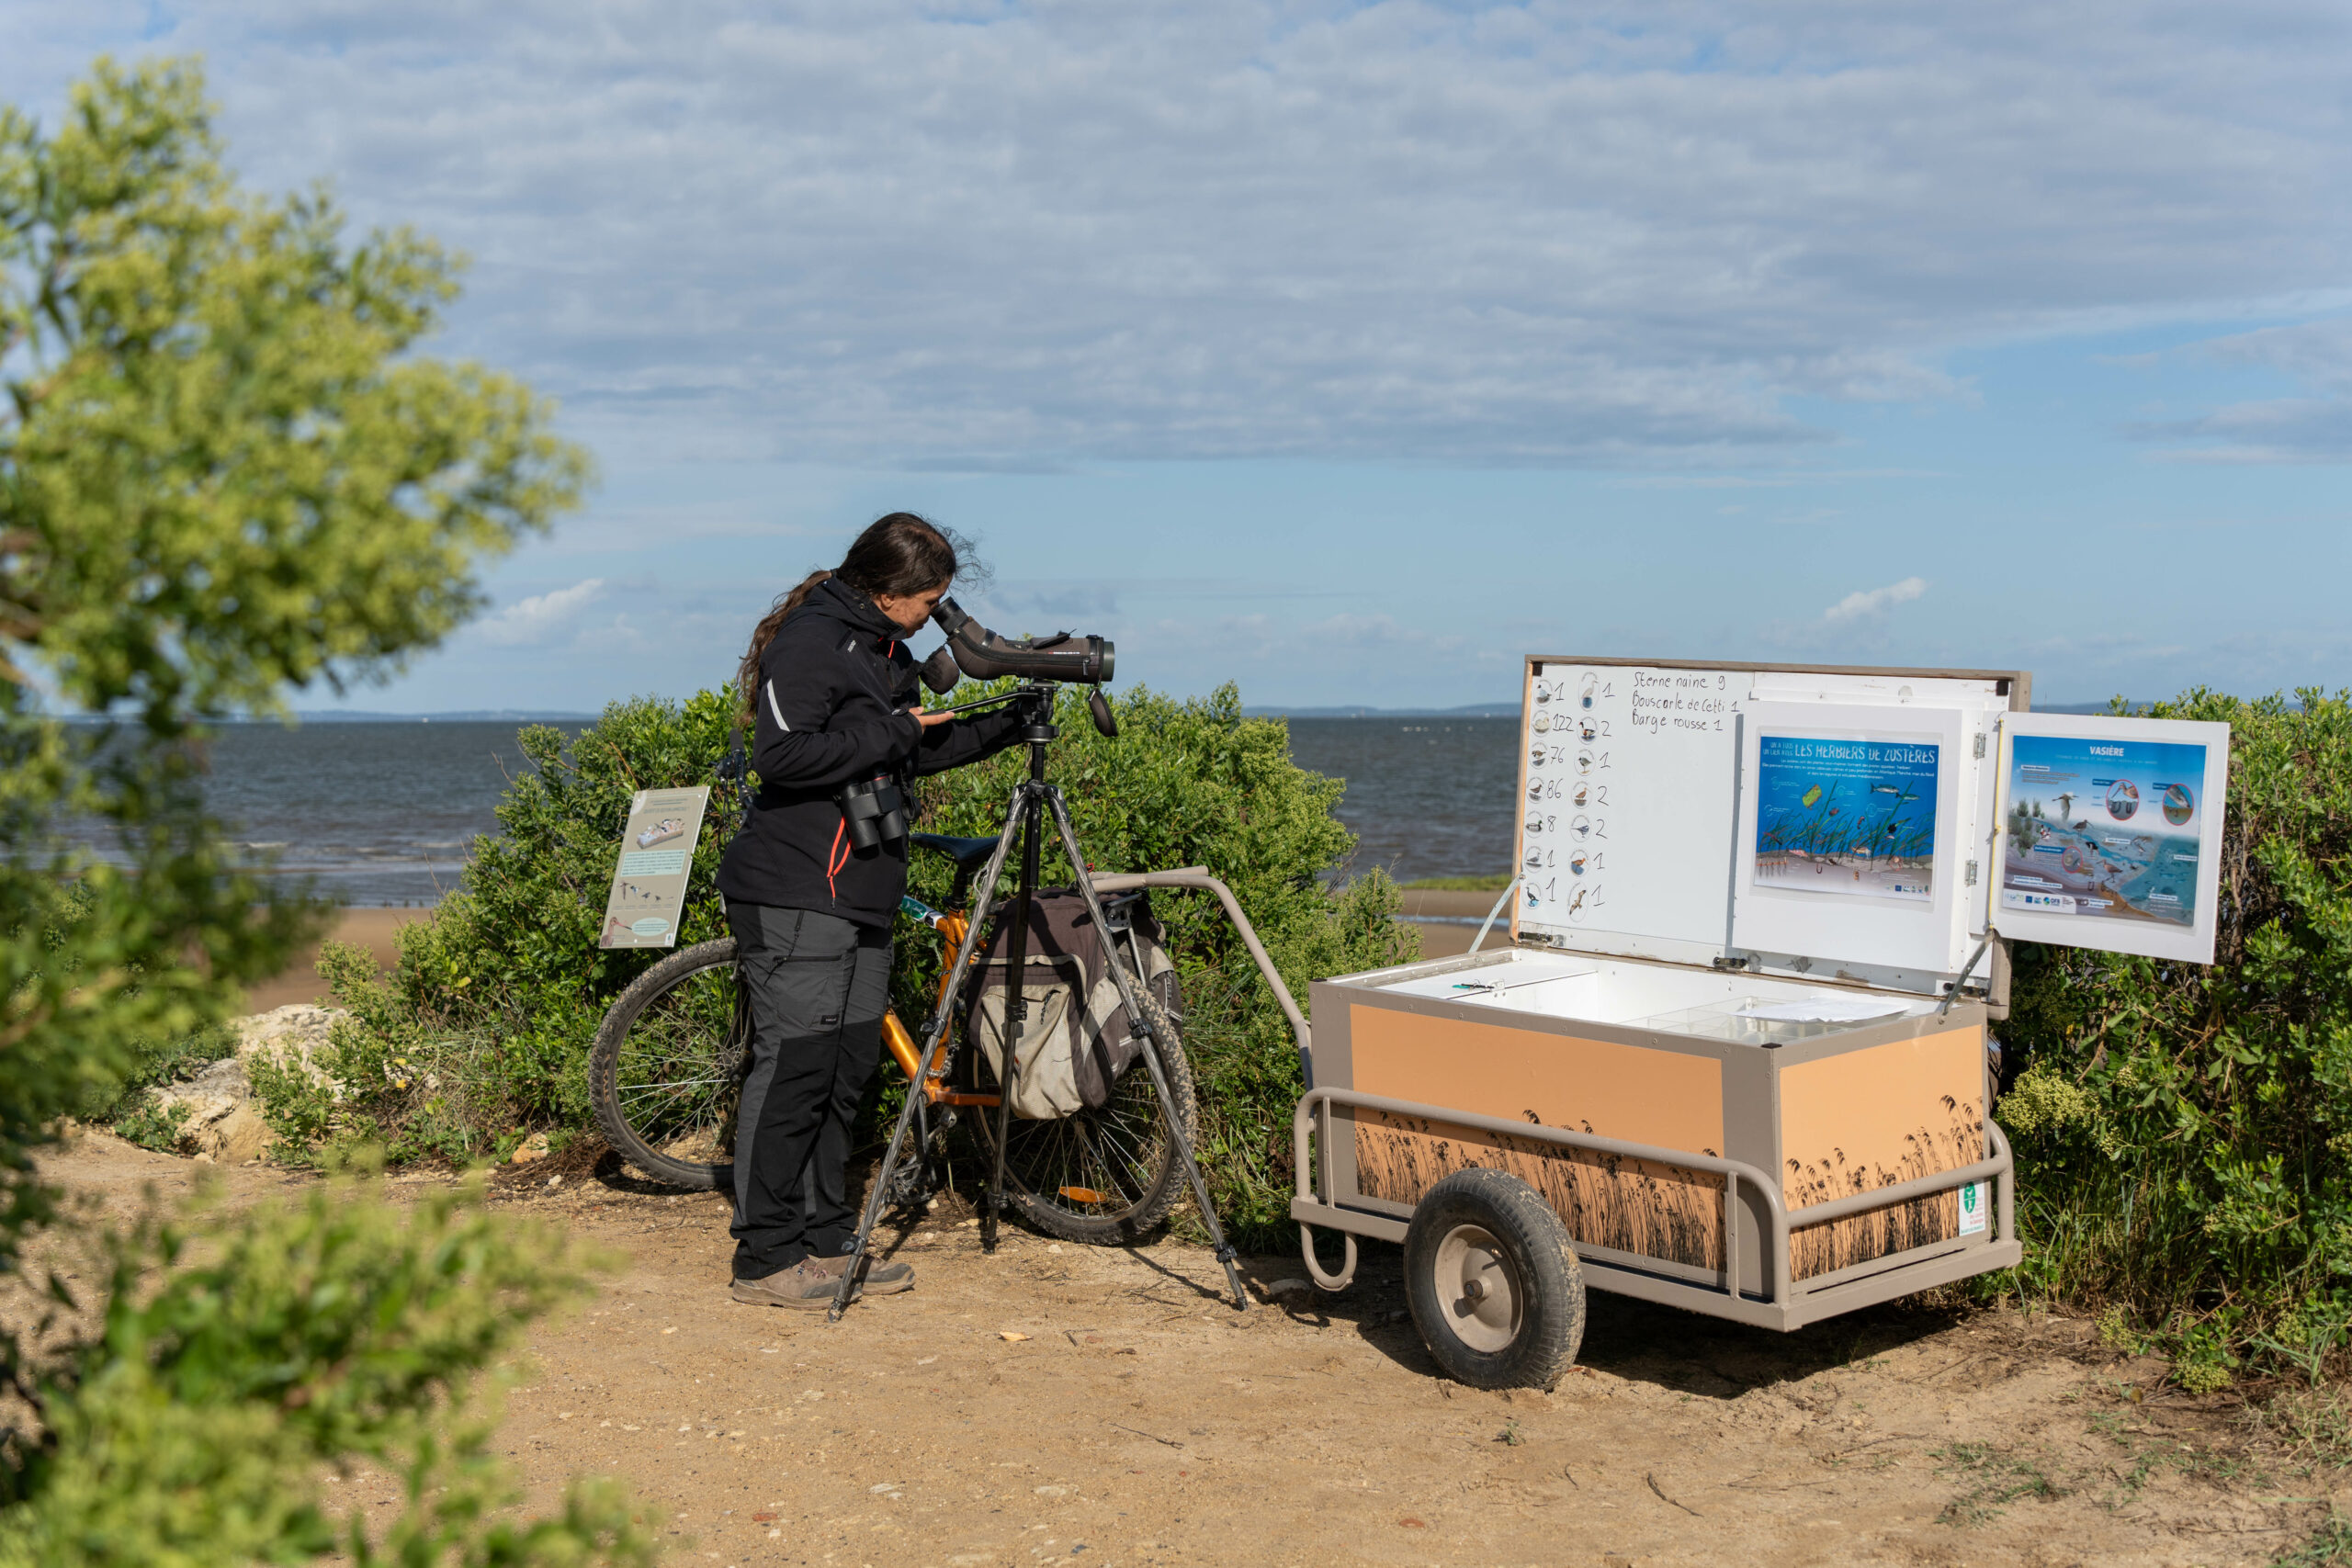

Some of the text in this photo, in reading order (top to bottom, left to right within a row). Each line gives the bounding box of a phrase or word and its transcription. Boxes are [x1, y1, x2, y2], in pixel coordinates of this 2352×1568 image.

[1602, 682, 1615, 698] 1
[1634, 671, 1725, 691] Sterne naine 9
[1555, 682, 1565, 701] 1
[1731, 701, 1740, 712] 1
[1553, 713, 1574, 731] 122
[1600, 720, 1611, 737] 2
[1632, 708, 1723, 734] Barge rousse 1
[1550, 746, 1566, 764] 76
[1600, 751, 1611, 769] 1
[1795, 744, 1813, 757] LES
[1815, 744, 1865, 761] HERBIERS
[2089, 745, 2124, 757] VASIÈRE
[1547, 778, 1564, 799] 86
[1598, 785, 1609, 807] 2
[1547, 815, 1556, 832] 8
[1595, 818, 1608, 840] 2
[1547, 850, 1555, 868] 1
[1593, 852, 1605, 870] 1
[1545, 876, 1555, 902] 1
[1591, 884, 1606, 907] 1
